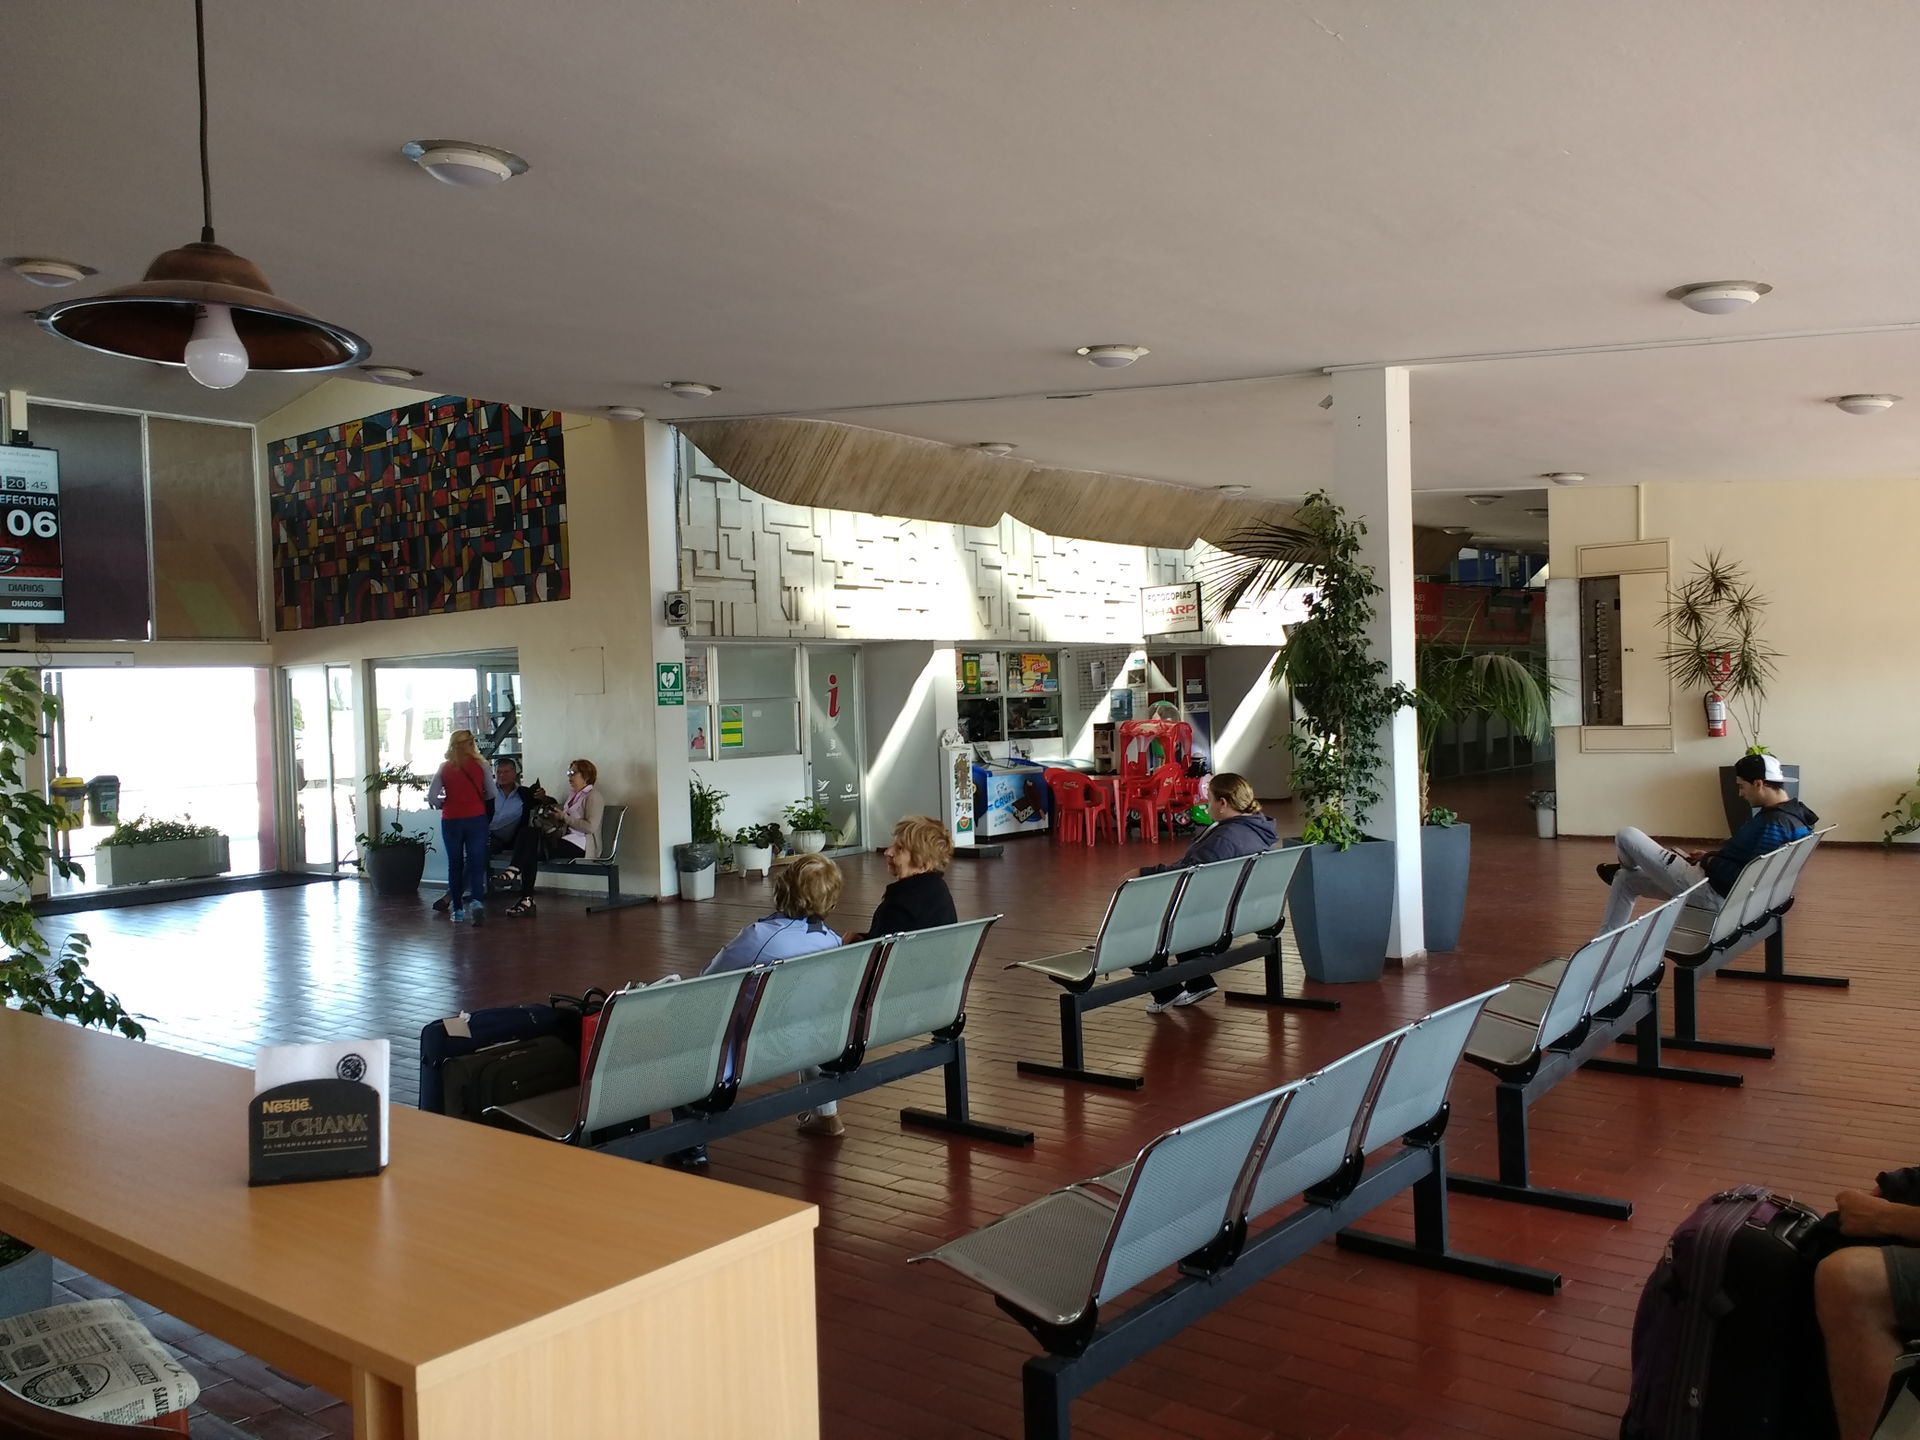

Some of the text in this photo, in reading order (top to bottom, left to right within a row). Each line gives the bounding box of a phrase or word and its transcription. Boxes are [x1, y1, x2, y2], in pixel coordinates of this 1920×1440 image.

[6, 509, 58, 538] 06
[8, 583, 44, 593] DIARIOS
[1147, 590, 1192, 602] FOTOCOPIAS
[11, 600, 44, 608] DIARIOS
[1145, 604, 1196, 617] SHARP
[262, 1120, 290, 1139] EL
